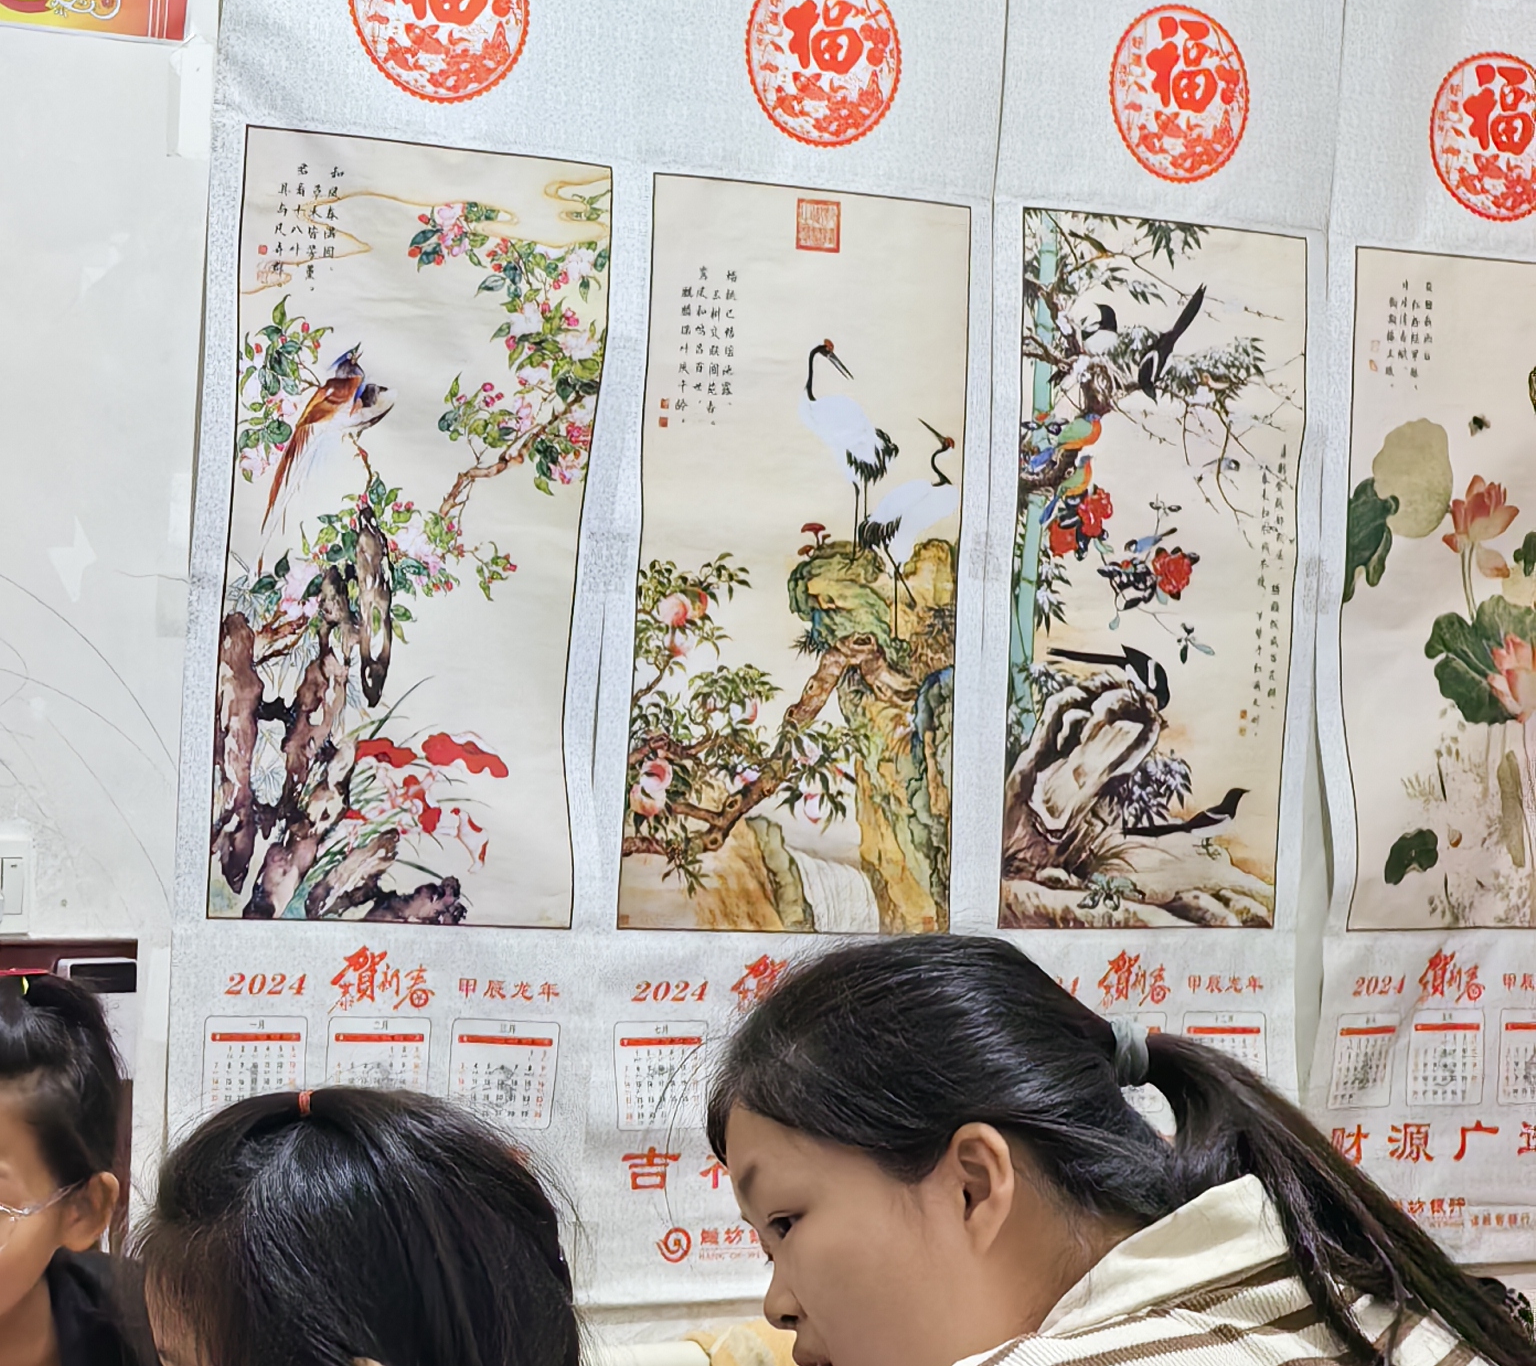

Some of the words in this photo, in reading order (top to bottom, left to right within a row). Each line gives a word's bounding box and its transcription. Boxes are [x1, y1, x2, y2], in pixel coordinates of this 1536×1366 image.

[1146, 16, 1218, 113] 福
[1464, 63, 1533, 155] 福
[224, 972, 307, 997] 2024
[458, 976, 560, 1001] 甲辰龙年
[631, 980, 710, 1003] 2024
